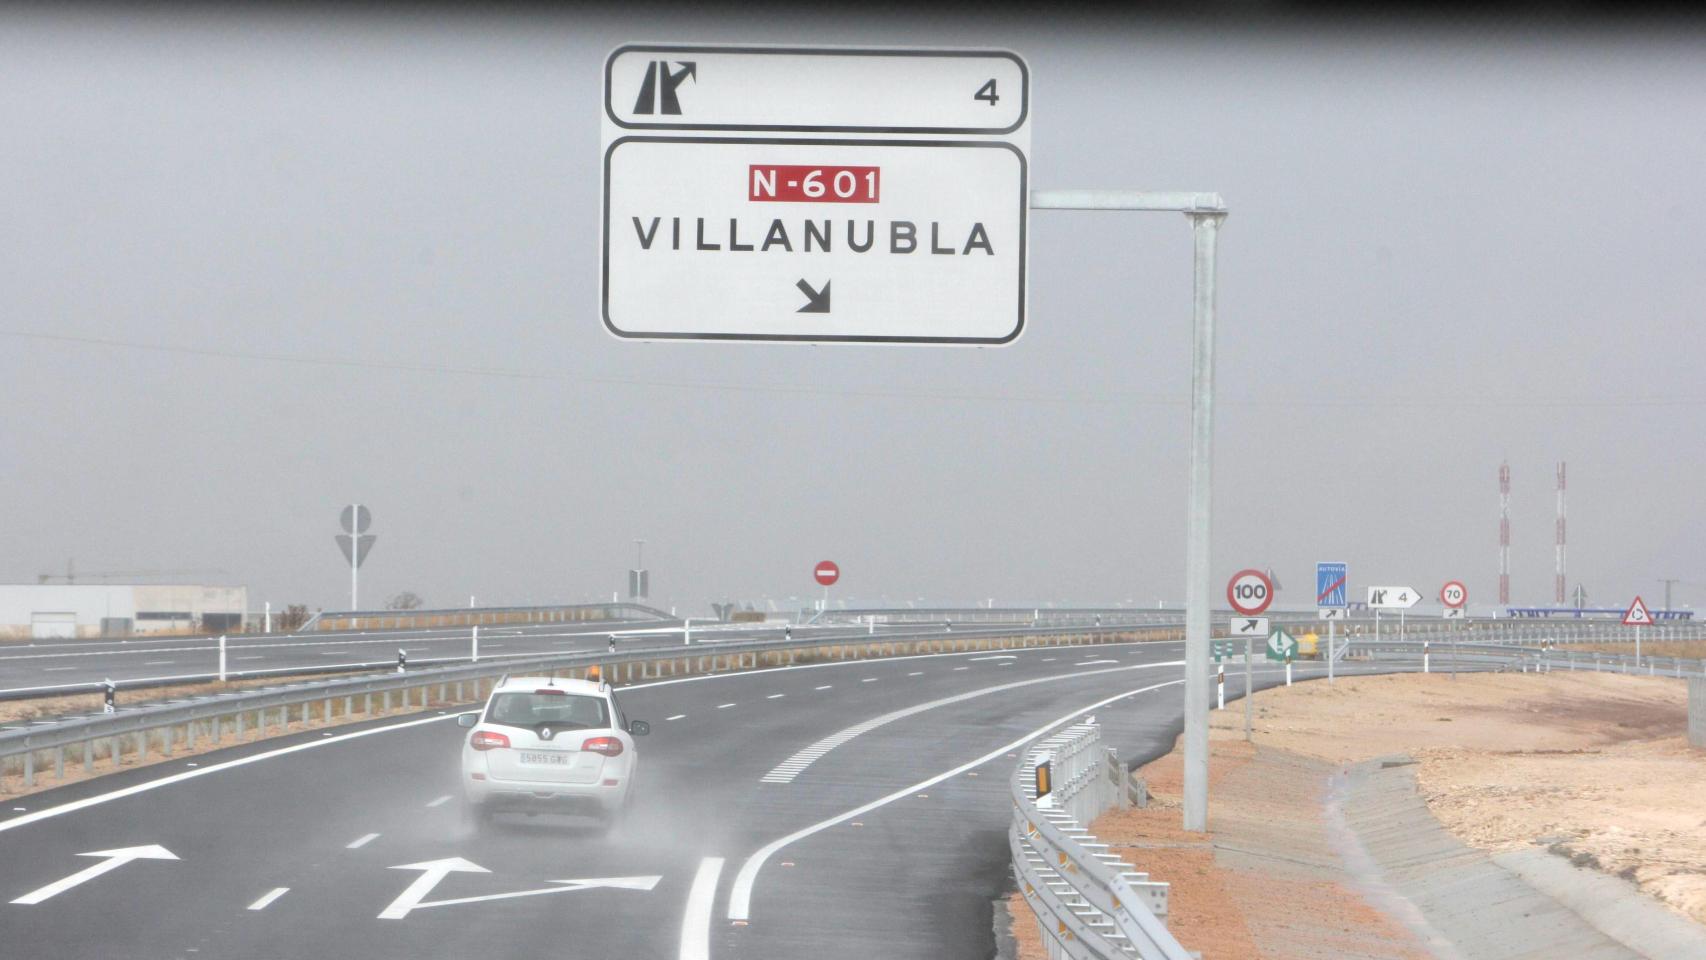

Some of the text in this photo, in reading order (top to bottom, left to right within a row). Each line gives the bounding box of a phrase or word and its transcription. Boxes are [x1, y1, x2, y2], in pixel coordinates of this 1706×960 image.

[974, 78, 1000, 107] 4
[753, 169, 876, 200] N-601
[631, 216, 995, 256] VILLANUBLA
[1234, 584, 1267, 599] 100
[1398, 592, 1408, 602] 4
[1446, 590, 1461, 600] 70
